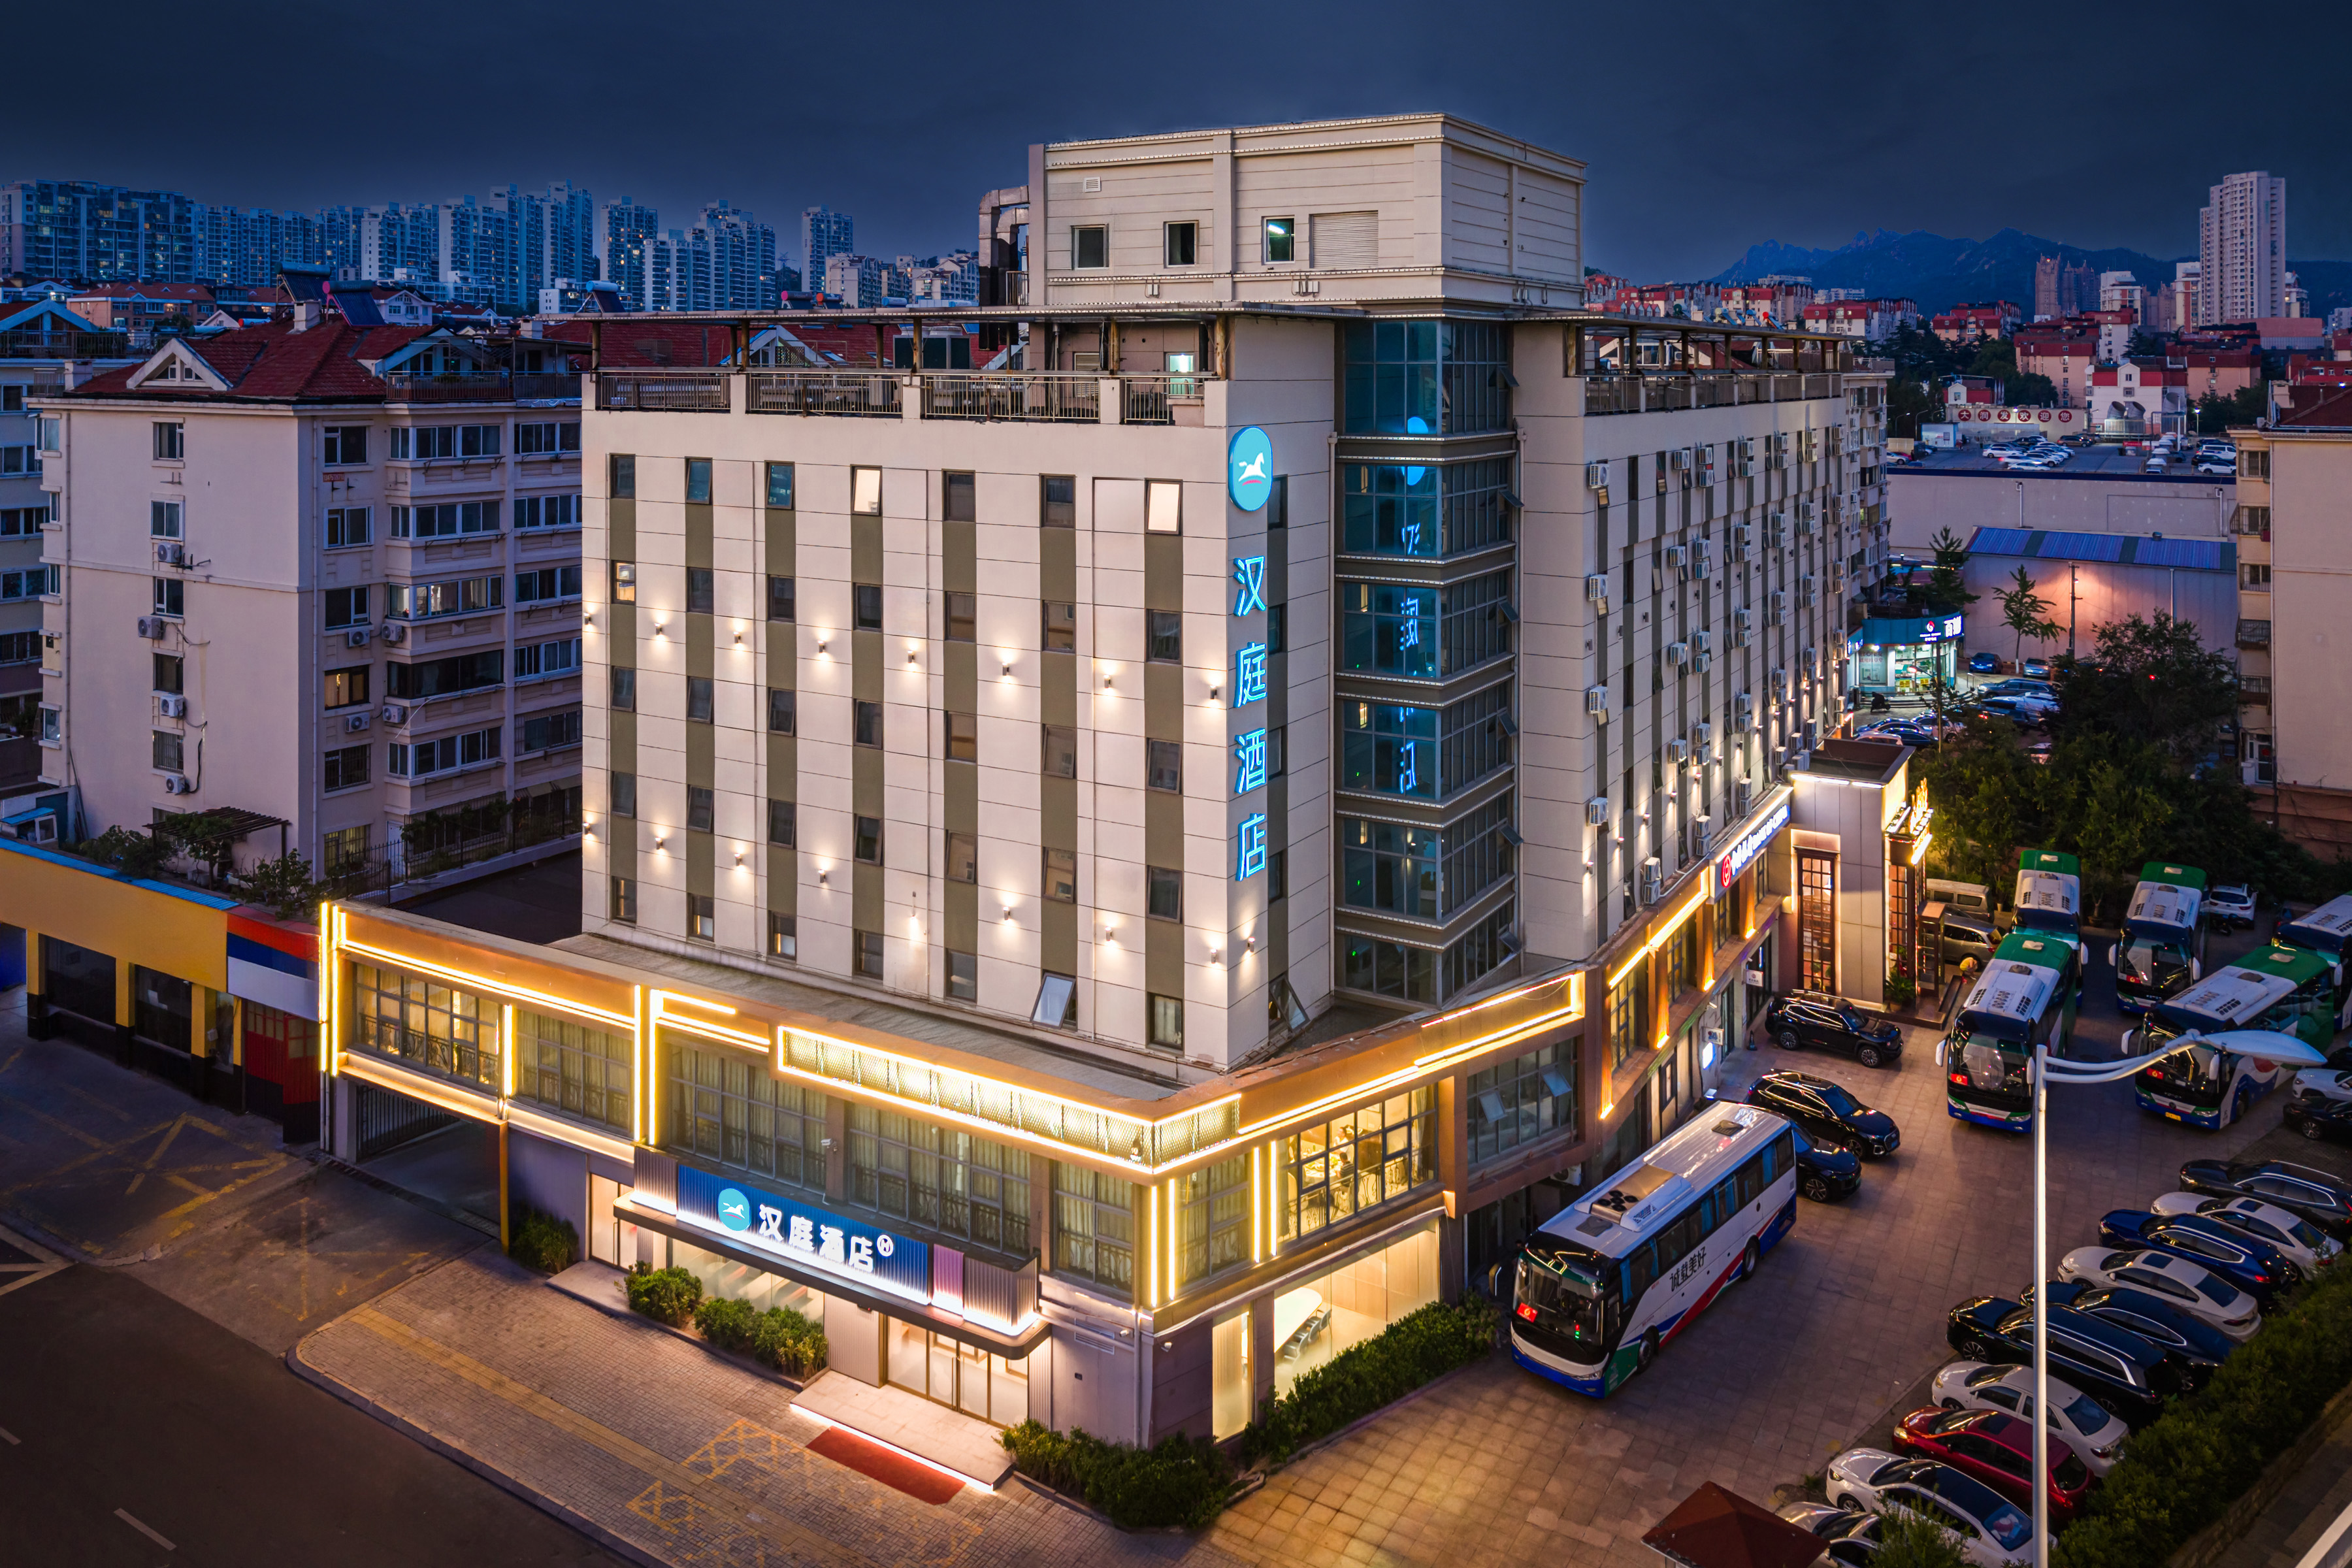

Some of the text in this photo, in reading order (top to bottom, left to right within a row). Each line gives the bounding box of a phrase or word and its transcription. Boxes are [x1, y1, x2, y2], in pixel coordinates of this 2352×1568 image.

[1960, 410, 2070, 421] 大润发欢迎您
[1233, 555, 1267, 882] 汉庭酒店
[759, 1203, 874, 1272] 汉庭酒店
[1669, 1246, 1707, 1292] 诚载美好
